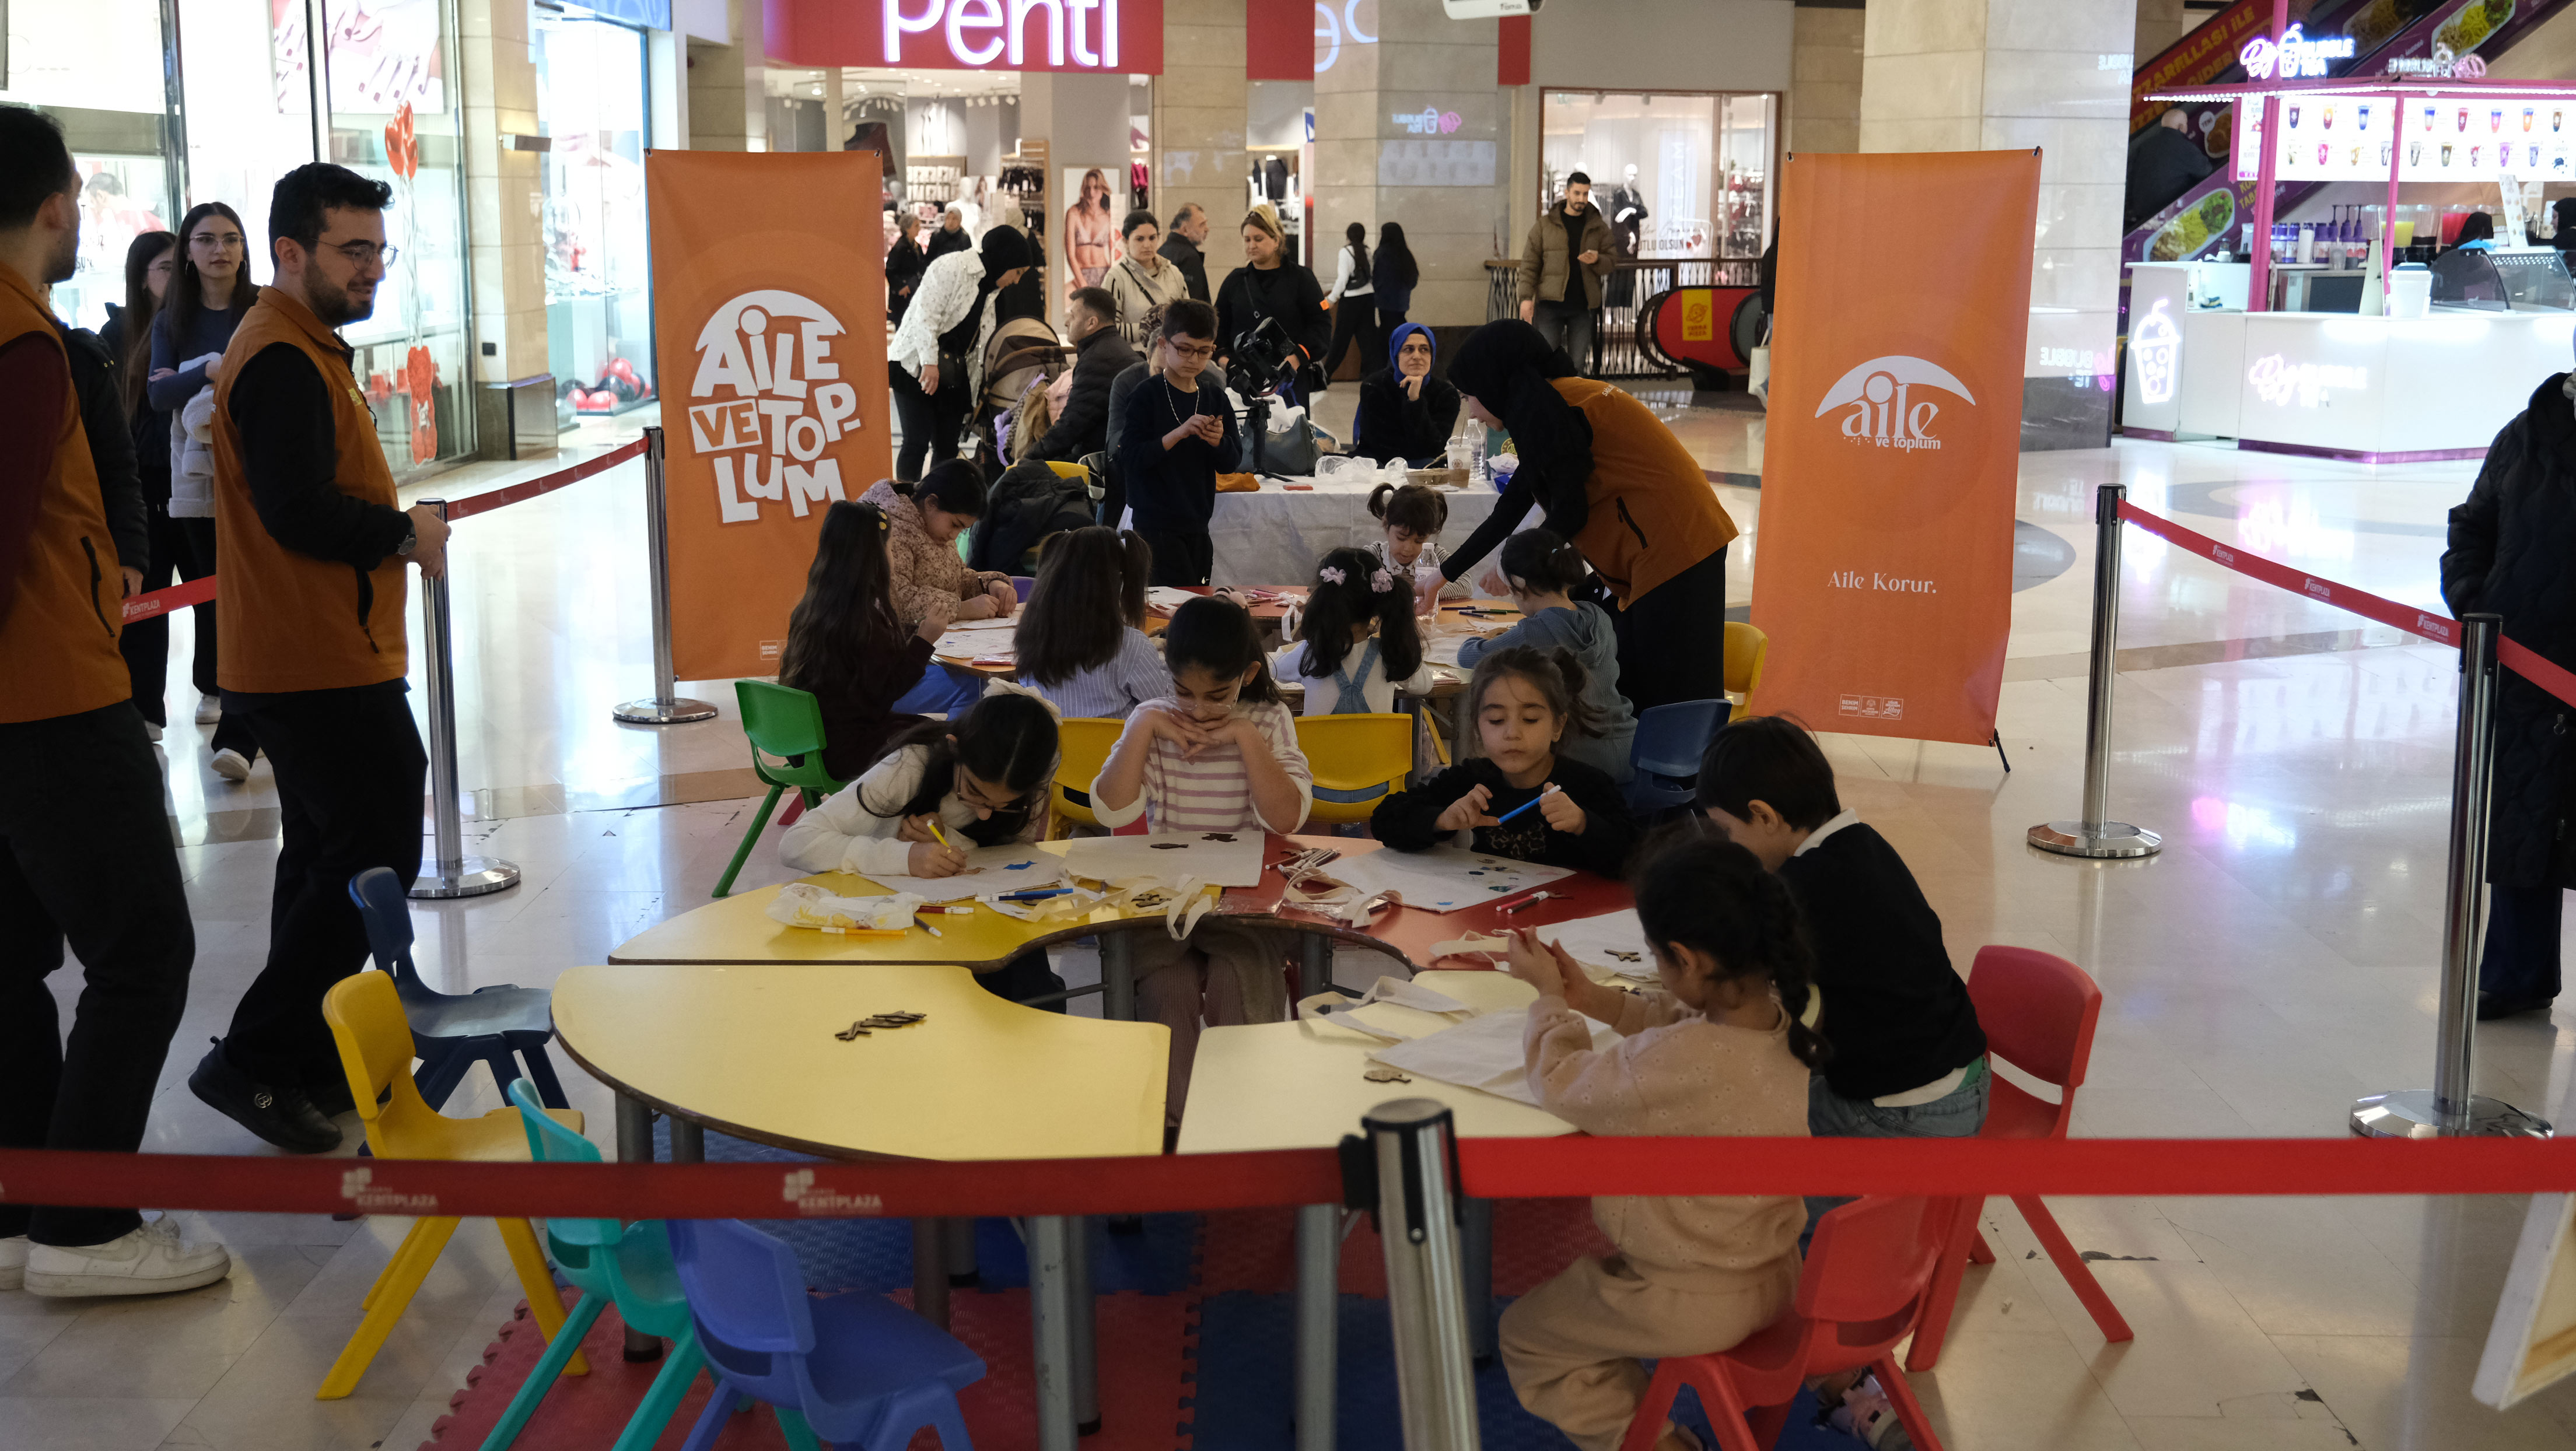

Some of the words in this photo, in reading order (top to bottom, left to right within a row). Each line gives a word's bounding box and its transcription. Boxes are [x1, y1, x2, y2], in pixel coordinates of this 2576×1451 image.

[884, 0, 1119, 67] Penti
[1842, 375, 1940, 439] aile
[691, 402, 760, 448] VE
[1875, 437, 1889, 448] ve
[1894, 437, 1941, 453] toplum
[713, 453, 846, 524] LUM
[1827, 570, 1865, 589] Aile
[1873, 572, 1937, 594] Korur.
[130, 600, 160, 616] KENTPLAZA
[2423, 619, 2449, 637] KENTPLAZA
